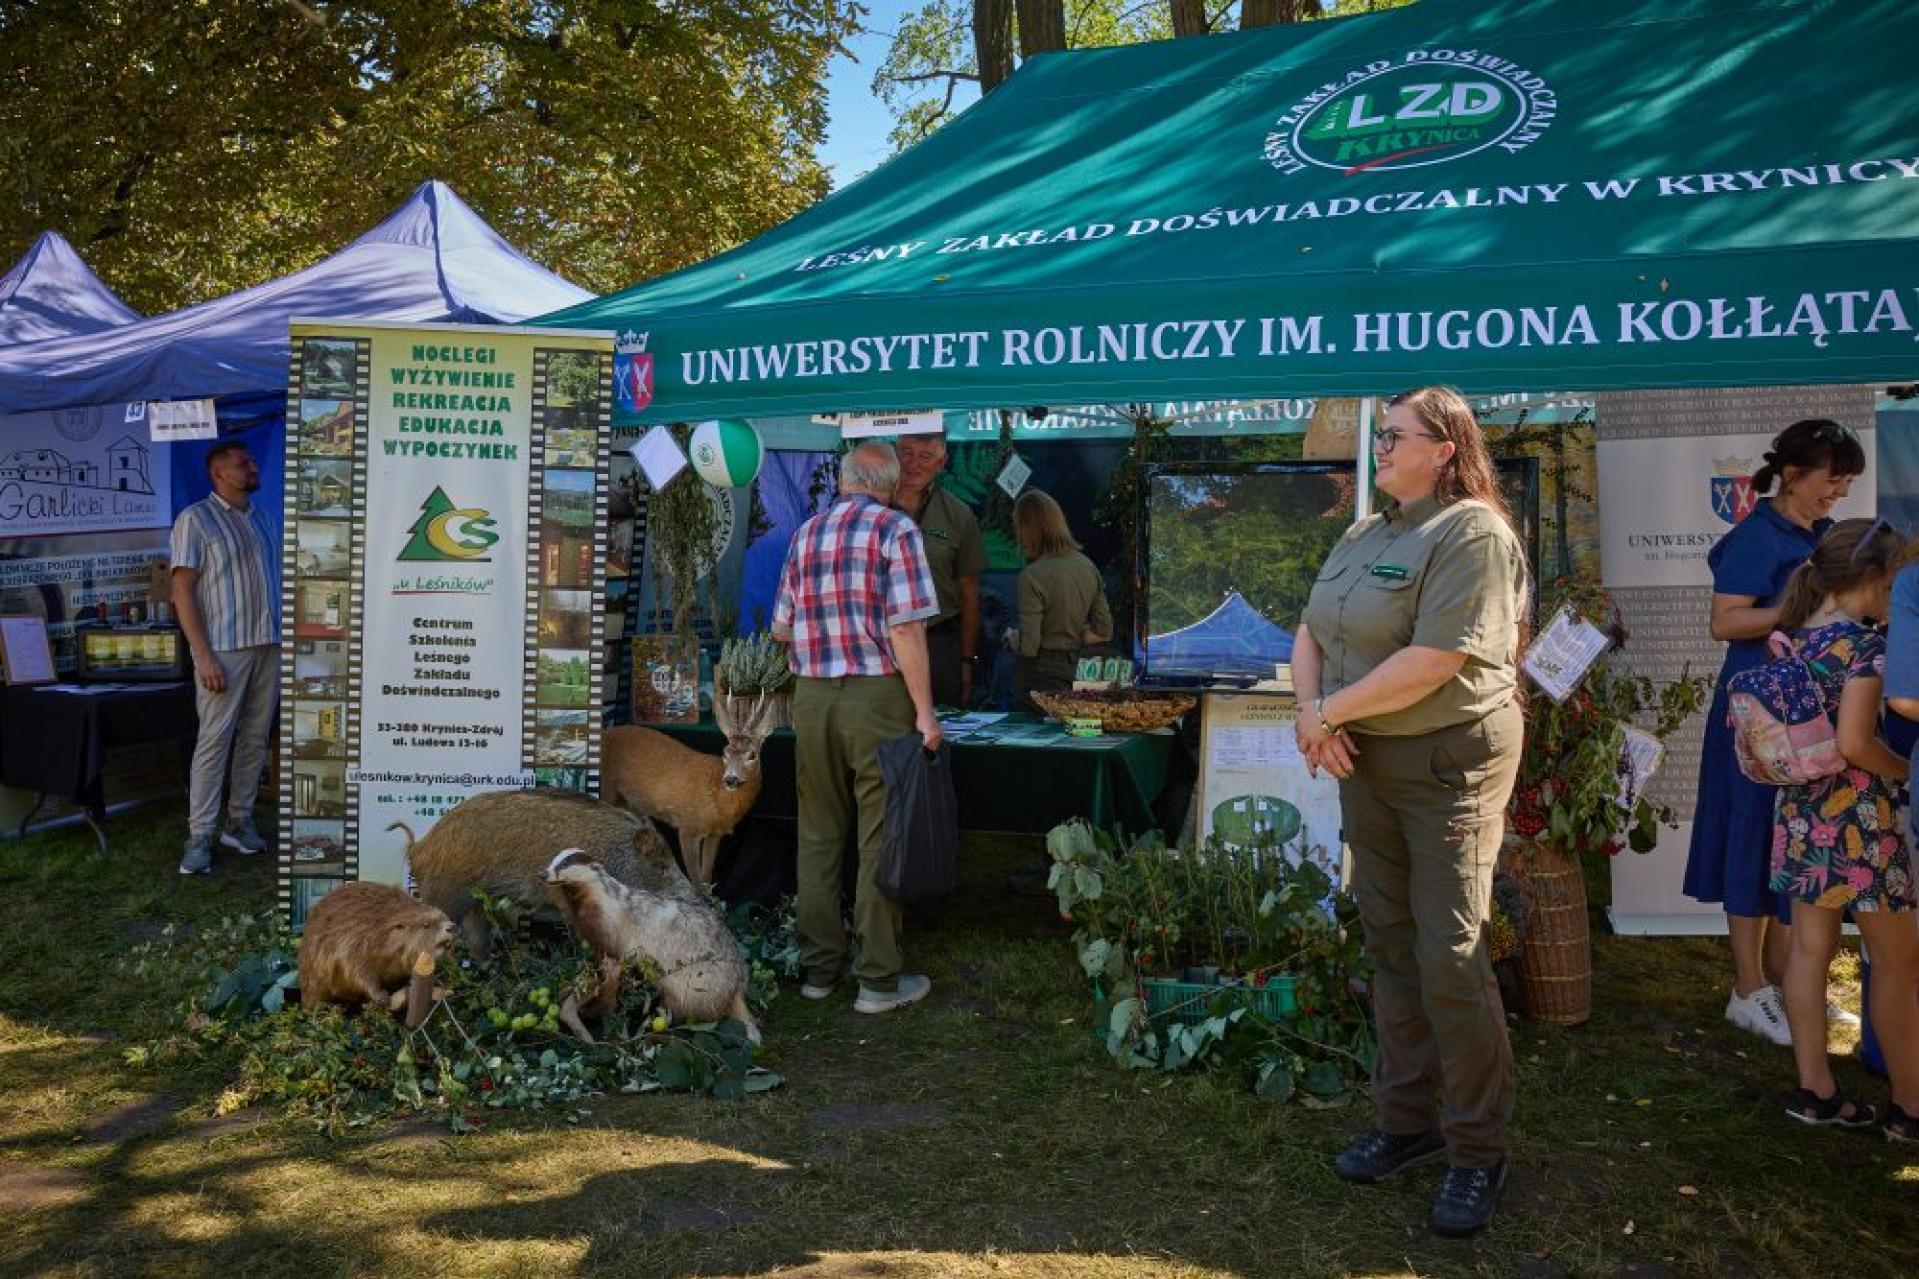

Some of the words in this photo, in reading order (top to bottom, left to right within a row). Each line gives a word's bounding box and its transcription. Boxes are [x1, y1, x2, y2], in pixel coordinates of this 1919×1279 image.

[1347, 82, 1502, 129] LZD
[796, 240, 925, 274] LEŚNY
[935, 223, 1115, 255] ZAKŁAD
[1124, 183, 1569, 238] DOŚWIADCZALNY
[1584, 177, 1642, 201] W
[1656, 156, 1919, 197] KRYNICY
[412, 344, 497, 365] NOCLEGI
[681, 331, 990, 386] UNIWERSYTET
[1001, 318, 1247, 367] ROLNICZY
[1258, 315, 1337, 356] IM.
[1352, 303, 1602, 353] HUGONA
[390, 364, 516, 389] WYŻYWIENIE
[392, 391, 513, 413] REKREACJA
[398, 418, 504, 437] EDUKACJA
[382, 439, 519, 461] WYPOCZYNEK
[413, 617, 473, 630] Centrum
[413, 651, 471, 665] Leśnego
[413, 668, 471, 681] Zakładu
[392, 736, 408, 747] ul.
